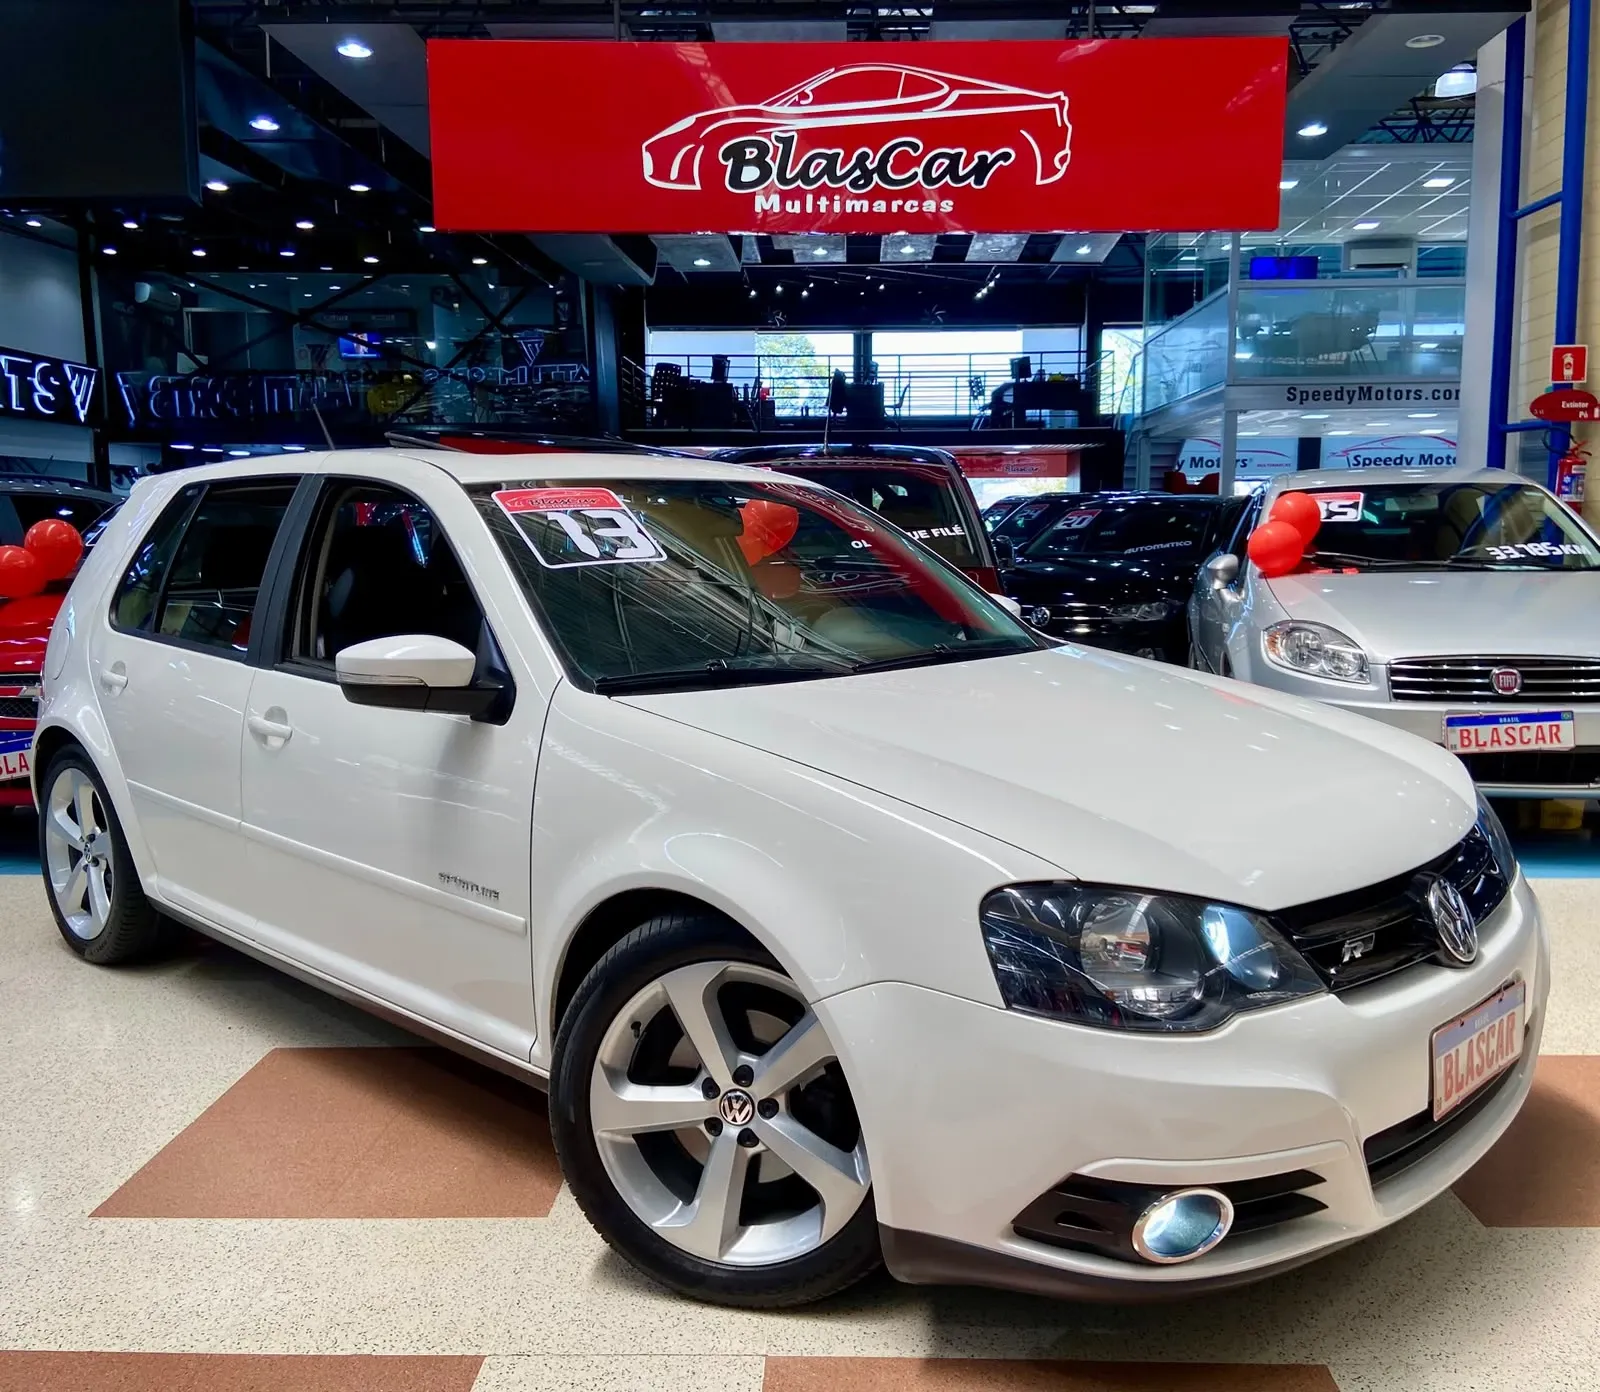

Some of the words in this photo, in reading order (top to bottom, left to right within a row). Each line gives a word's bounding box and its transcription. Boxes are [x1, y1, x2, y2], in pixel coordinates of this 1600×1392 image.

[719, 130, 1014, 194] BlasCar
[754, 194, 954, 214] Multimarcas
[1561, 400, 1589, 409] Extintor
[1189, 456, 1249, 469] Motrs
[1352, 453, 1413, 468] Speedy
[1060, 514, 1093, 529] 20
[907, 529, 931, 541] UE
[930, 524, 966, 538] FILÉ
[1498, 674, 1517, 689] FIAT
[1459, 724, 1562, 749] BLASCAR
[0, 752, 30, 776] LA
[1443, 1012, 1516, 1102] BLASCAR
